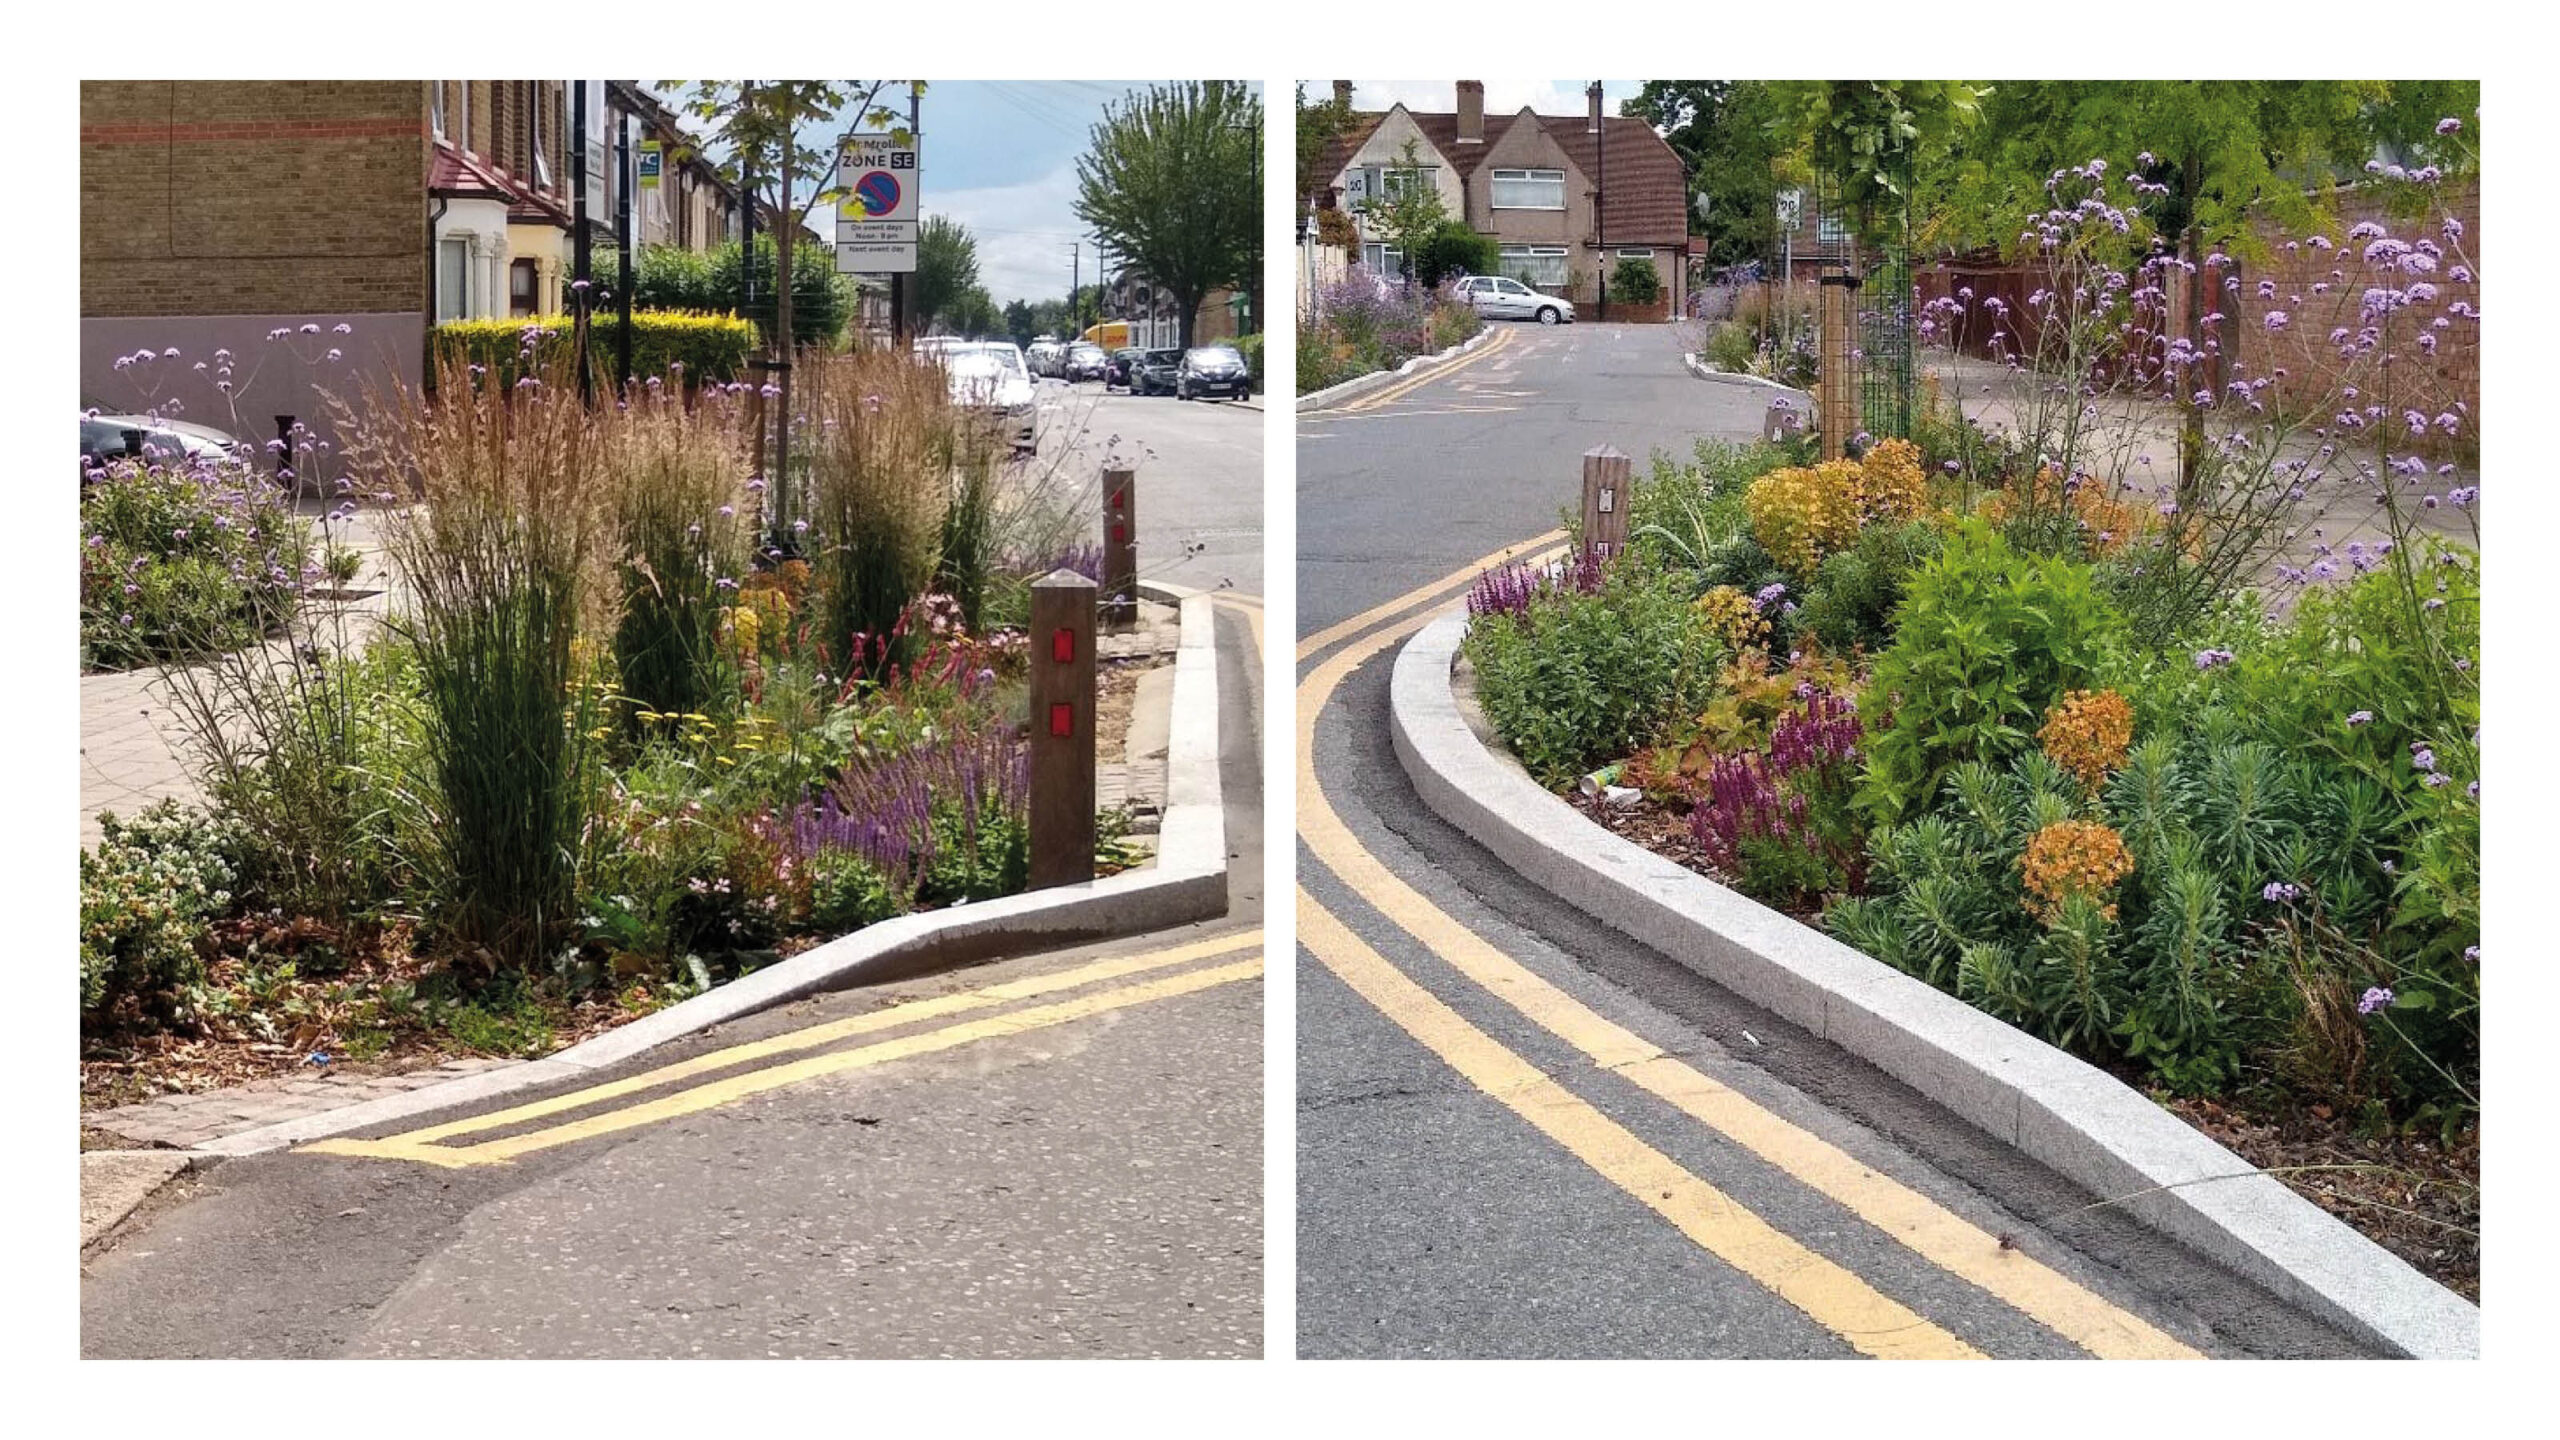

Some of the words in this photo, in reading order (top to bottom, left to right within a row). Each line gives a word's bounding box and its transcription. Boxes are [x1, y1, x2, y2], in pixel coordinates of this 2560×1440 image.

[843, 155, 886, 167] ZONE
[893, 154, 913, 167] SE
[1350, 180, 1361, 191] 20
